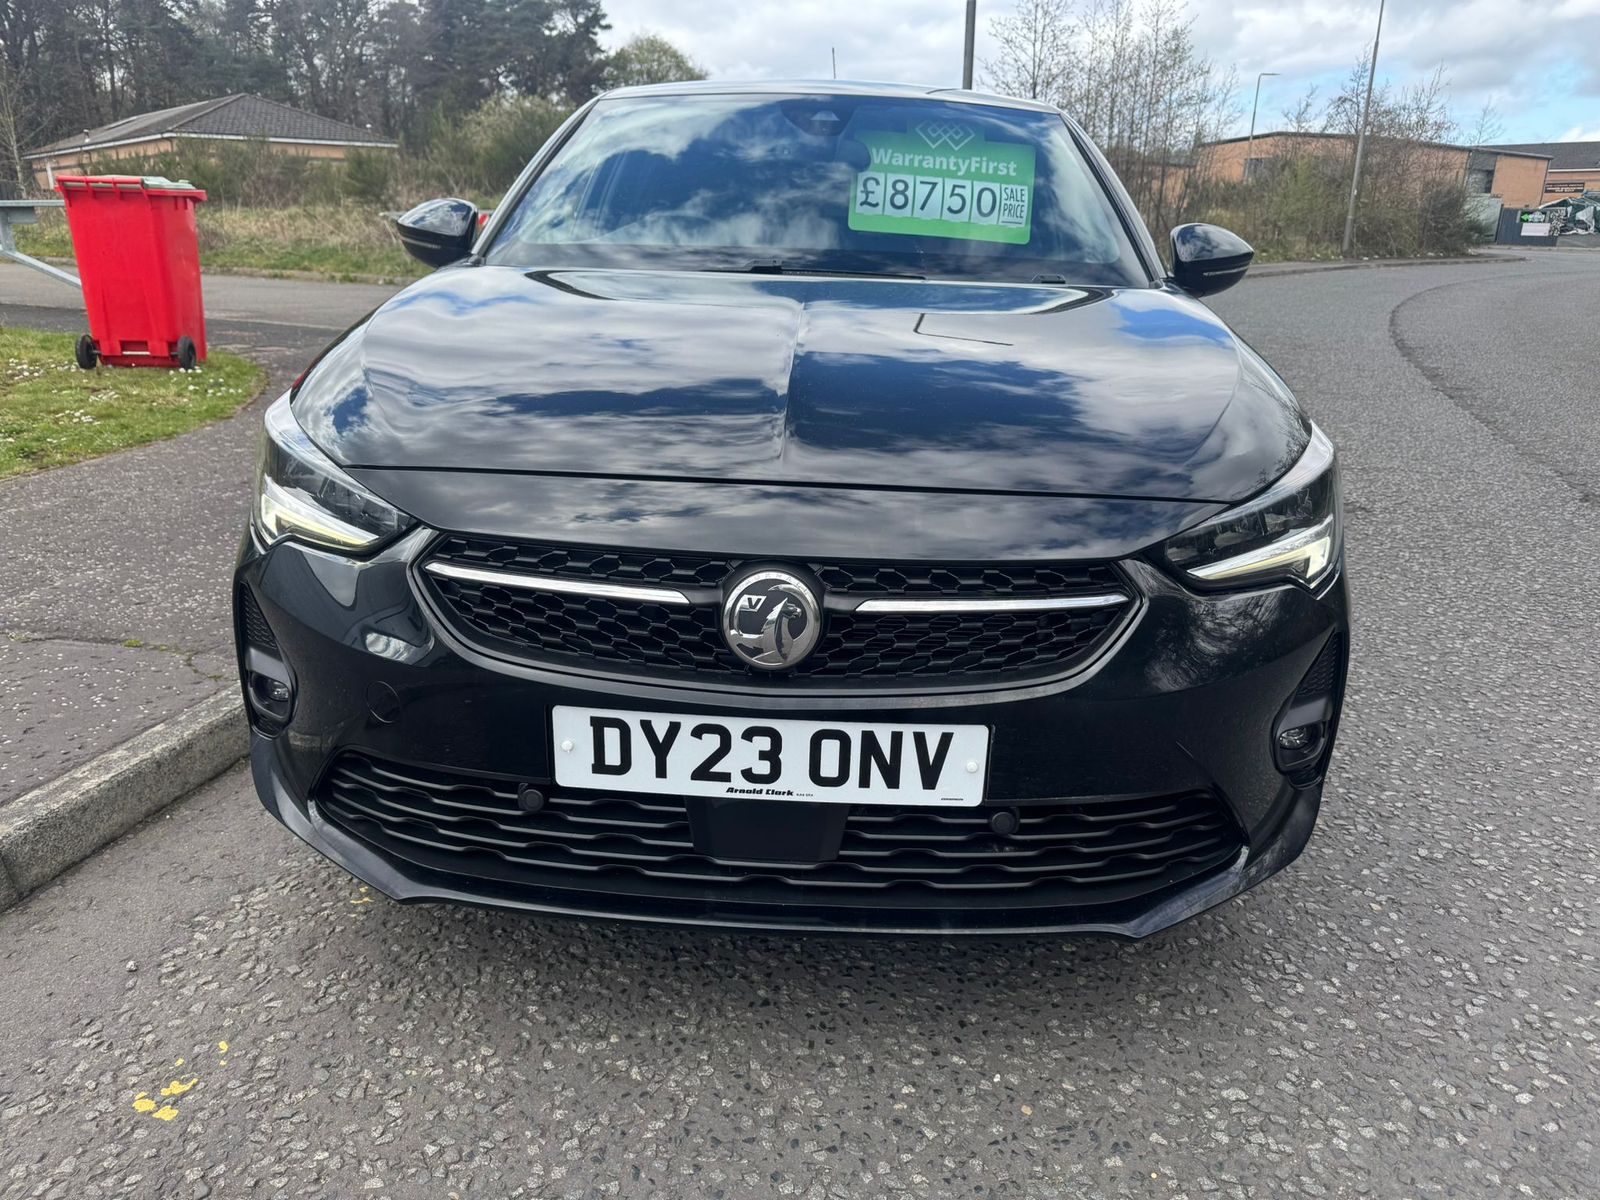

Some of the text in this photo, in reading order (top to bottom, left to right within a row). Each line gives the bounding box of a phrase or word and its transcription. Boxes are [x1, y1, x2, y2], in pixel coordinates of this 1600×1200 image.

[871, 148, 1017, 176] WarrantyFirst
[859, 176, 997, 218] £8750
[1003, 187, 1025, 203] SALE
[1002, 203, 1024, 219] PRICE
[747, 597, 762, 610] V
[589, 715, 955, 790] DY23 ONV
[726, 787, 763, 795] Arnold
[765, 789, 794, 797] Clark
